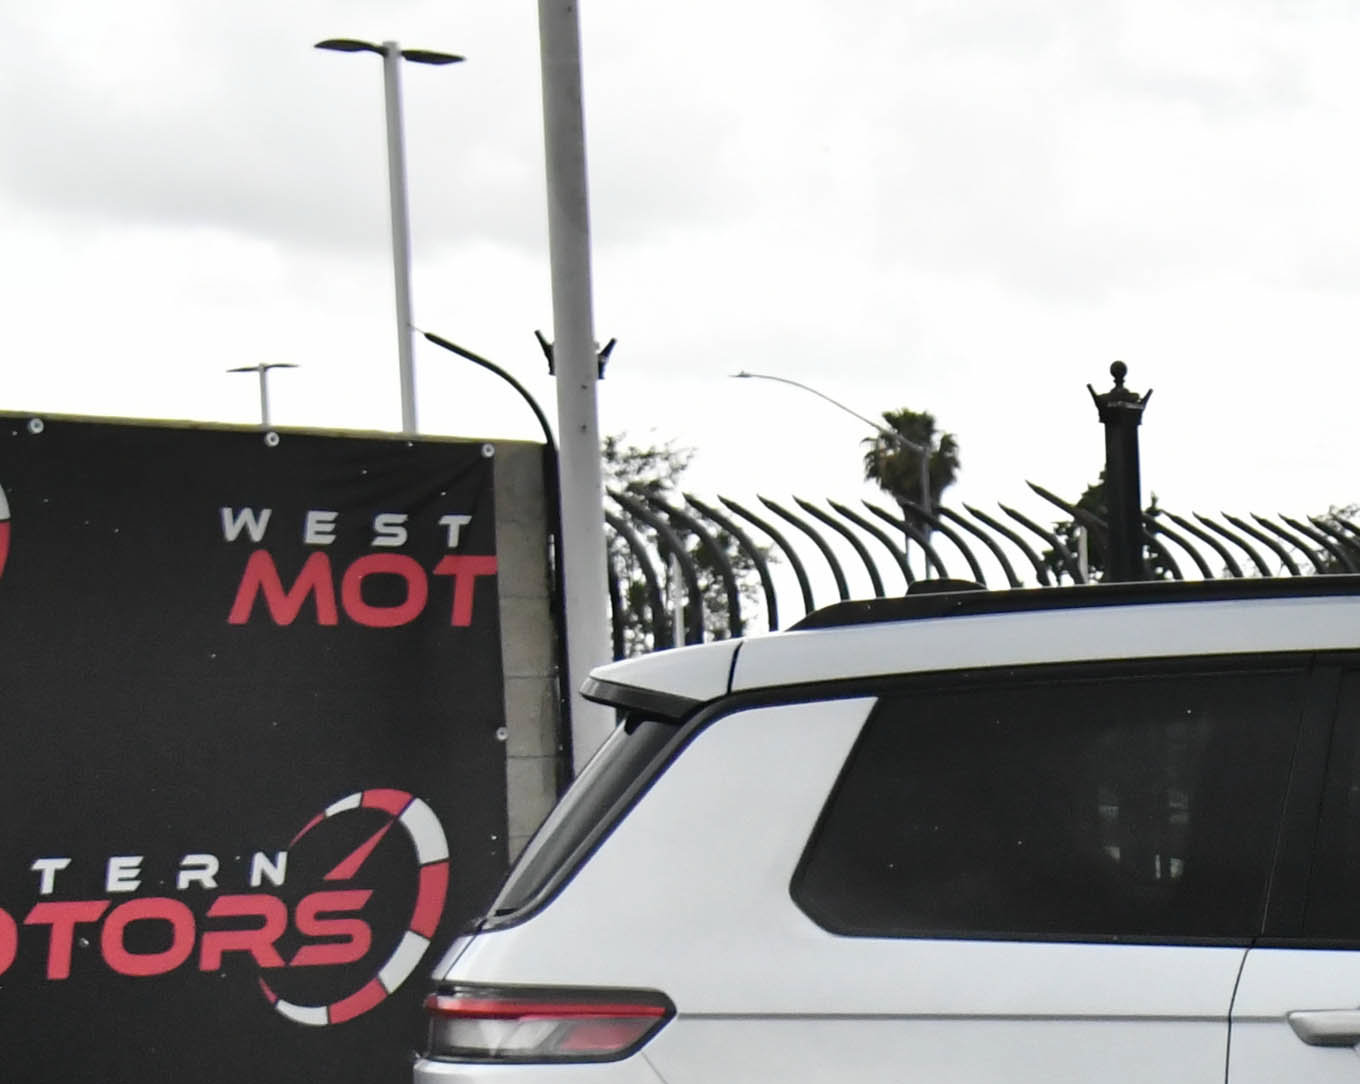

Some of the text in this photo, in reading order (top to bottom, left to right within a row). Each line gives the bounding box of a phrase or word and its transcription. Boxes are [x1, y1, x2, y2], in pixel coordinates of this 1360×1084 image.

[221, 507, 472, 548] WEST
[227, 549, 498, 628] MOT
[30, 851, 288, 894] TERN
[0, 889, 373, 980] TORS
